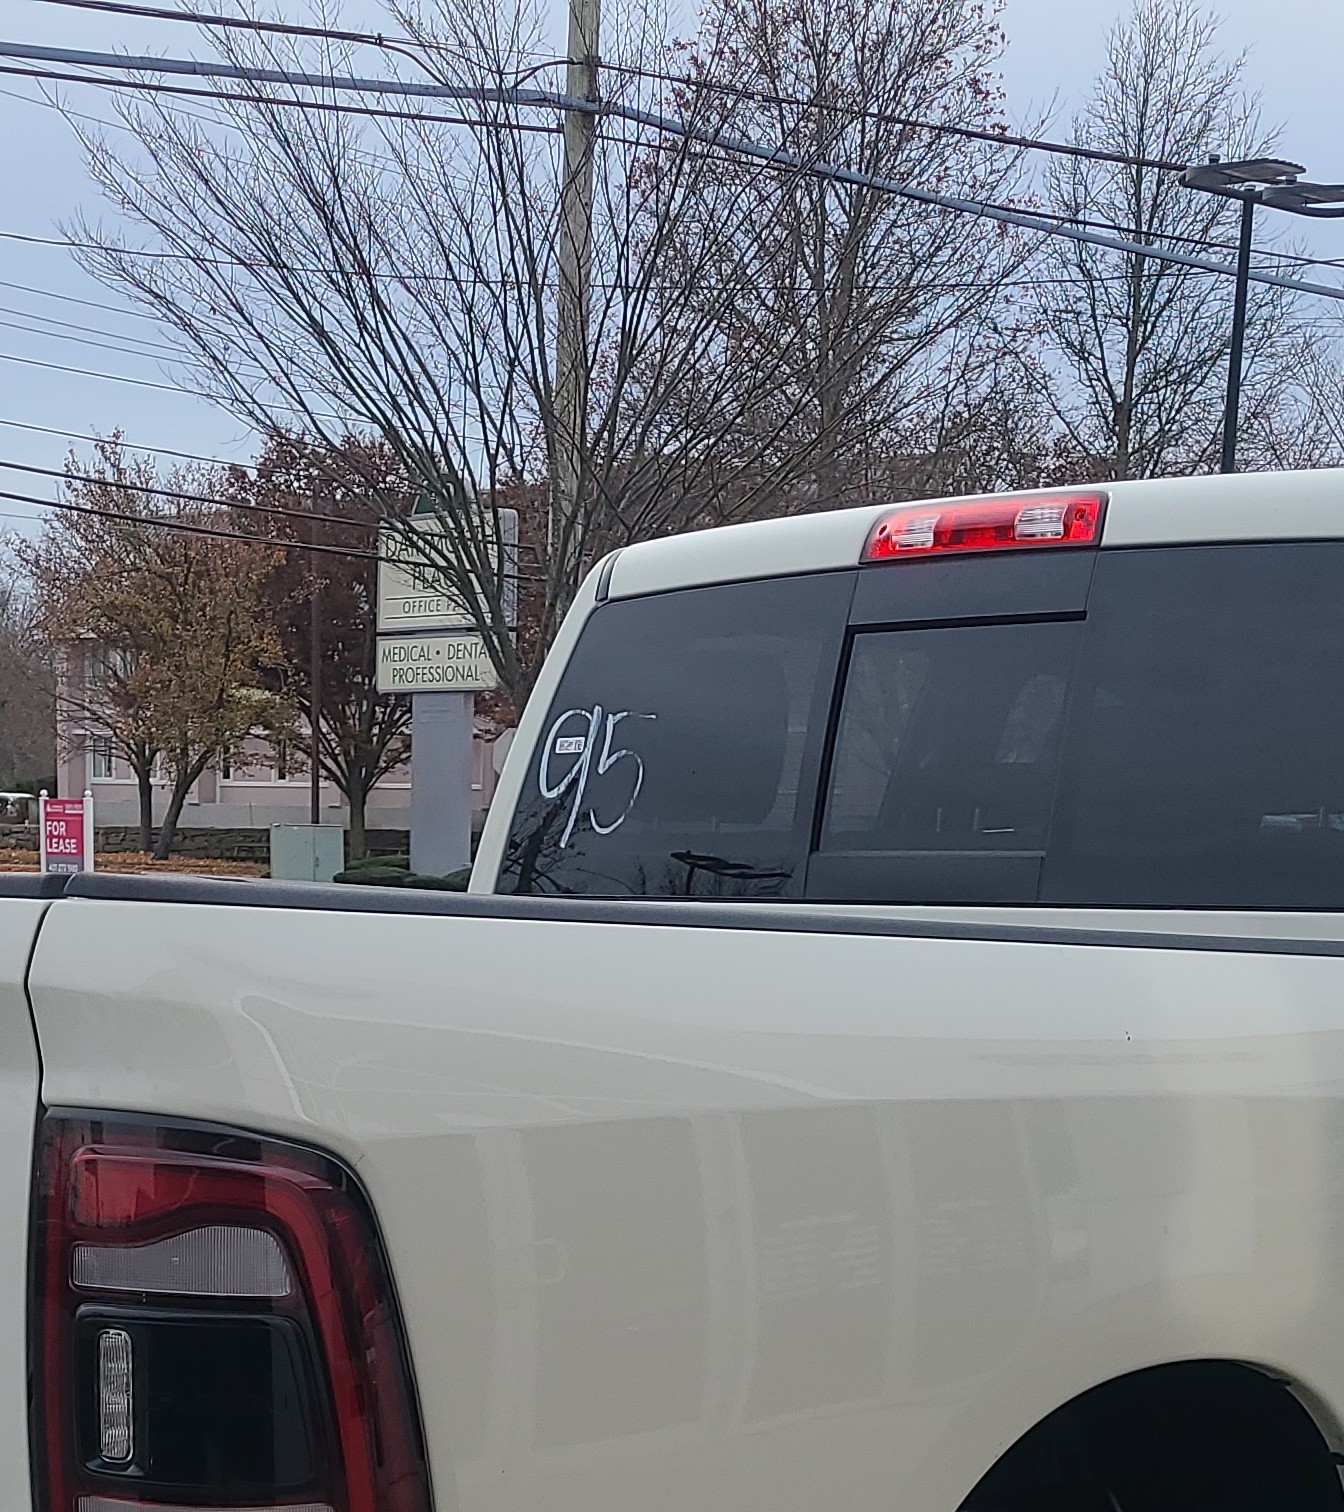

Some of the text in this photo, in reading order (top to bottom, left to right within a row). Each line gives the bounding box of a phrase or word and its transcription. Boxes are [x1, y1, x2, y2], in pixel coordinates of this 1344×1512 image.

[402, 599, 441, 614] OFFICE
[382, 645, 433, 663] MEDICAL
[392, 664, 481, 685] PROFESSIONAL
[539, 705, 657, 849] 95
[46, 821, 66, 836] FOR
[46, 838, 77, 853] LEASE
